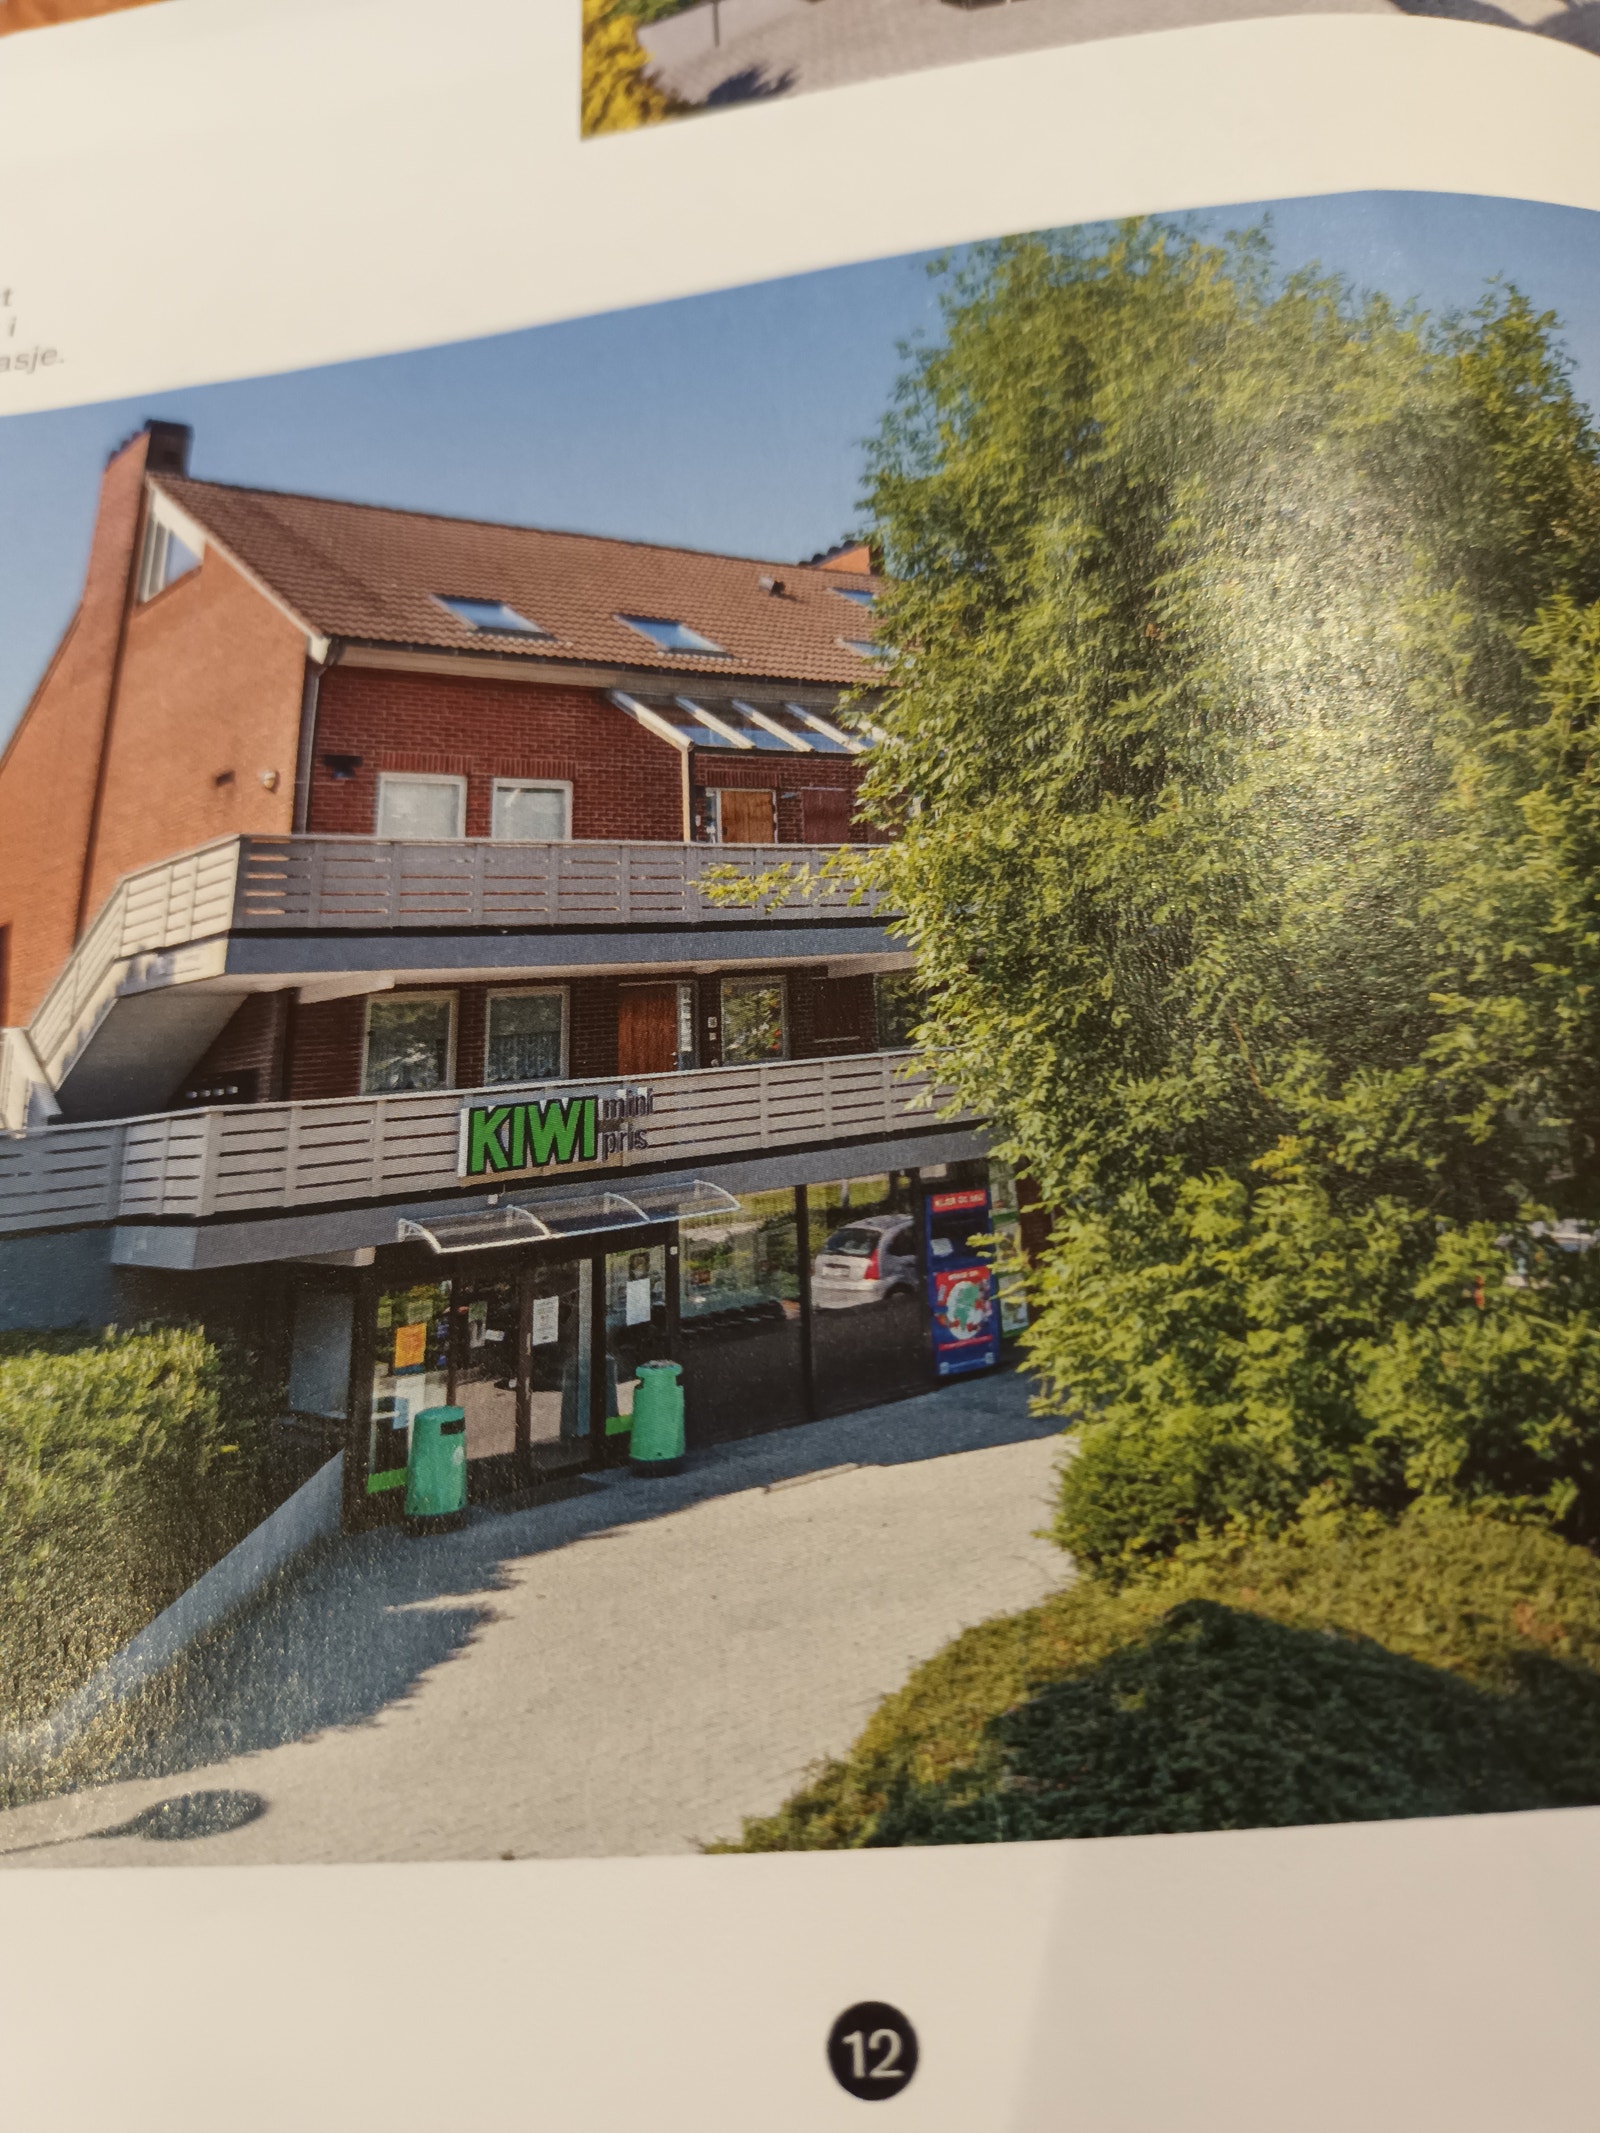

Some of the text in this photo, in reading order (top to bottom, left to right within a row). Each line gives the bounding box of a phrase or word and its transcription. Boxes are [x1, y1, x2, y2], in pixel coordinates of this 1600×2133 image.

[602, 1088, 653, 1119] mini
[467, 1096, 598, 1174] KIWI
[602, 1123, 648, 1162] pris
[841, 2028, 905, 2078] 12
